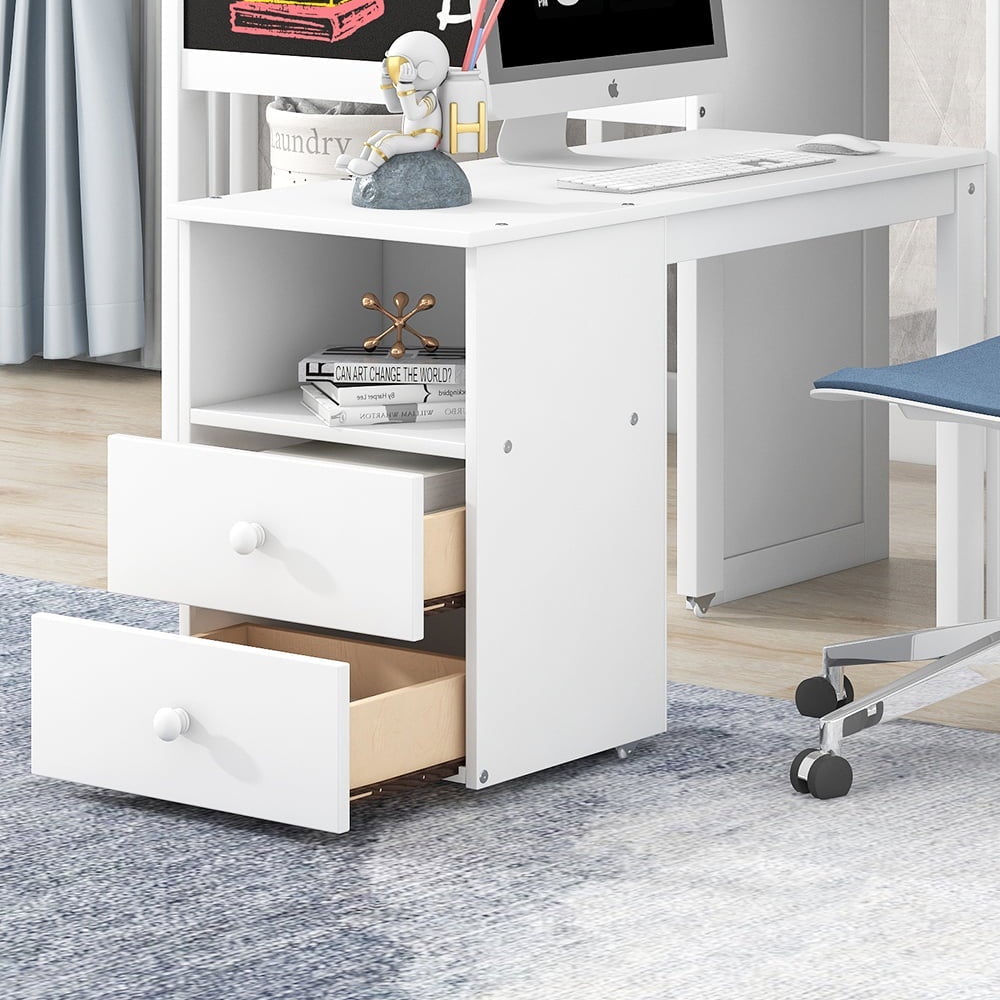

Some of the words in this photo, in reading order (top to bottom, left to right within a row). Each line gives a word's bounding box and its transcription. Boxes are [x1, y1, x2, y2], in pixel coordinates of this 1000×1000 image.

[449, 101, 487, 154] H
[336, 365, 352, 381] CAN
[353, 366, 368, 381] ART
[370, 366, 401, 382] CHANGE
[404, 367, 418, 382] THE
[420, 367, 453, 383] WORLD?
